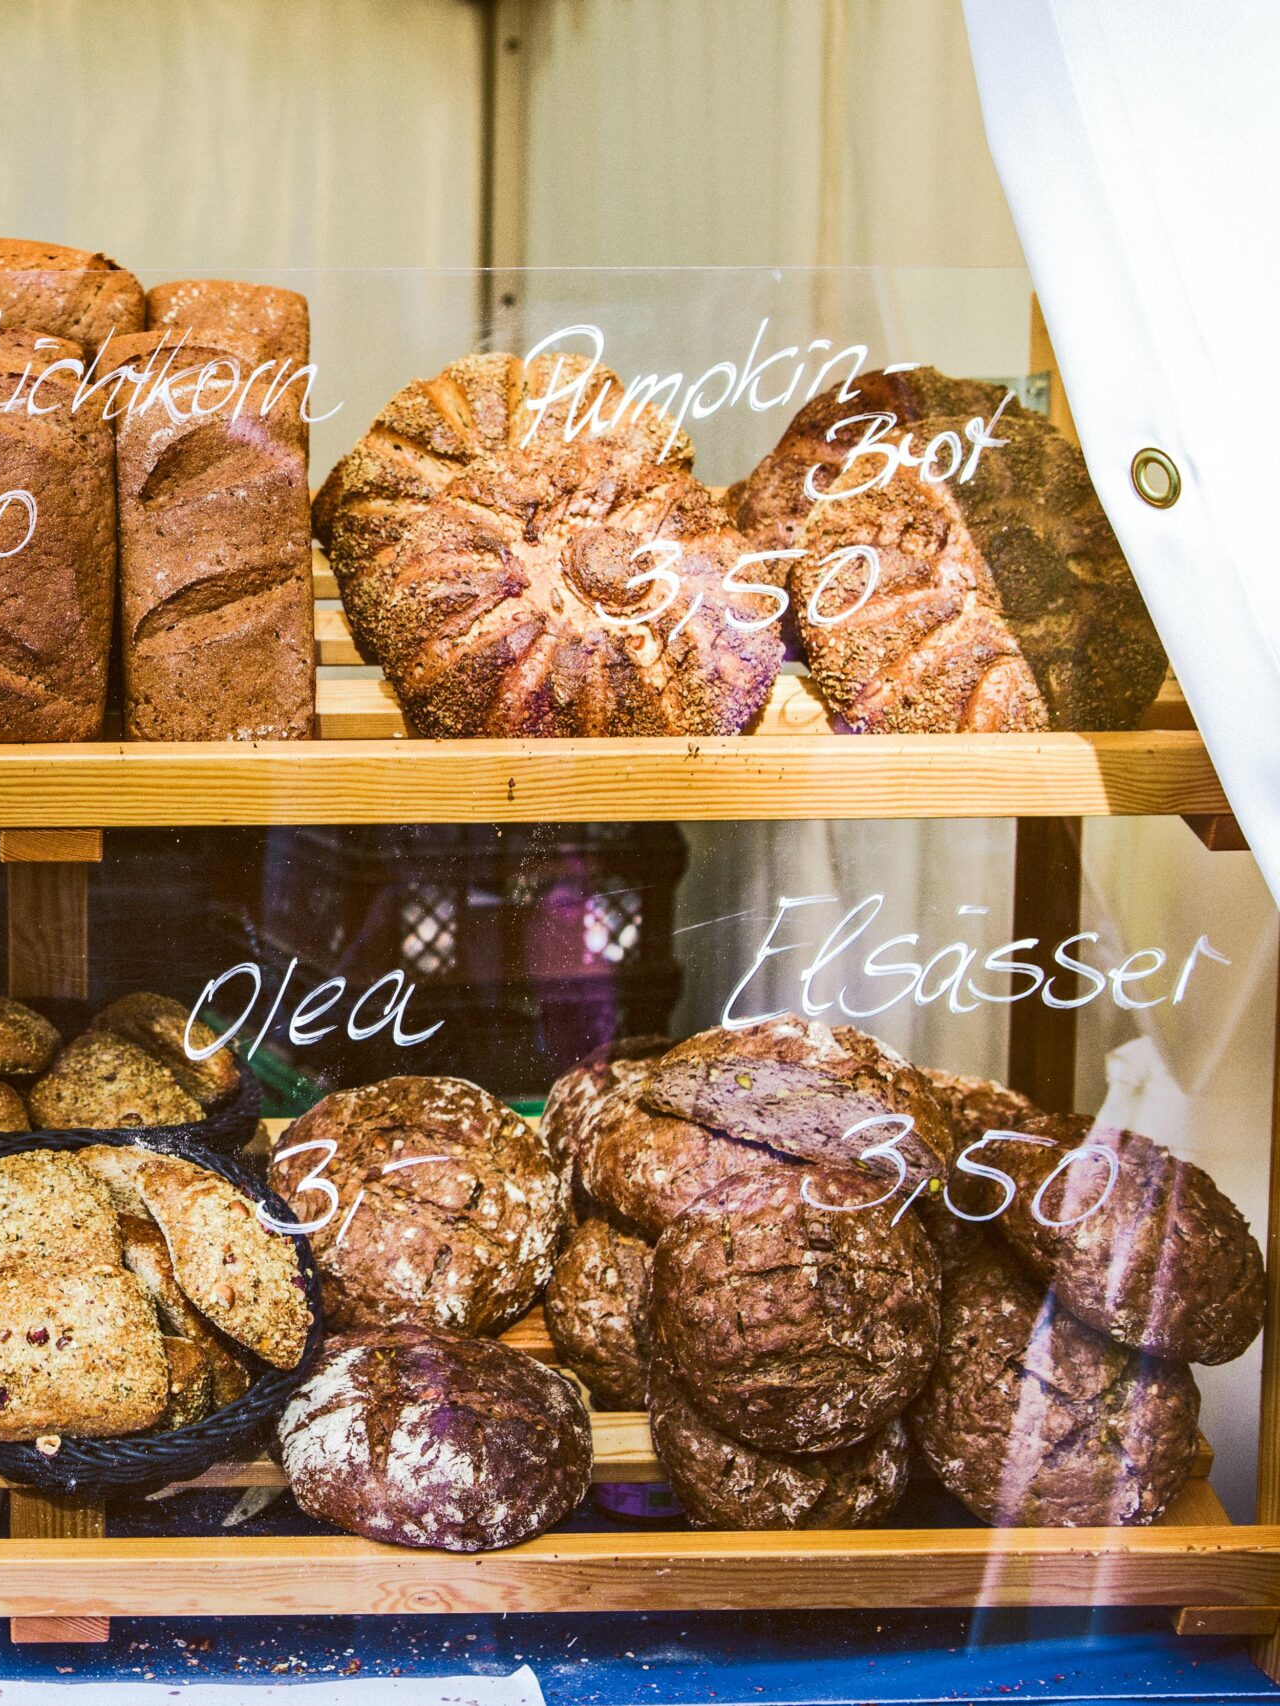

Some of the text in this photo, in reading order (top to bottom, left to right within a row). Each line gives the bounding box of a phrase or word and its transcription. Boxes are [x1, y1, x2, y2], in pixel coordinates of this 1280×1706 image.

[803, 390, 1018, 501] Brot
[595, 540, 880, 641] 3,50
[184, 957, 445, 1061] Olea
[722, 893, 1232, 1030] Elsässer
[800, 1114, 1119, 1228] 3,50
